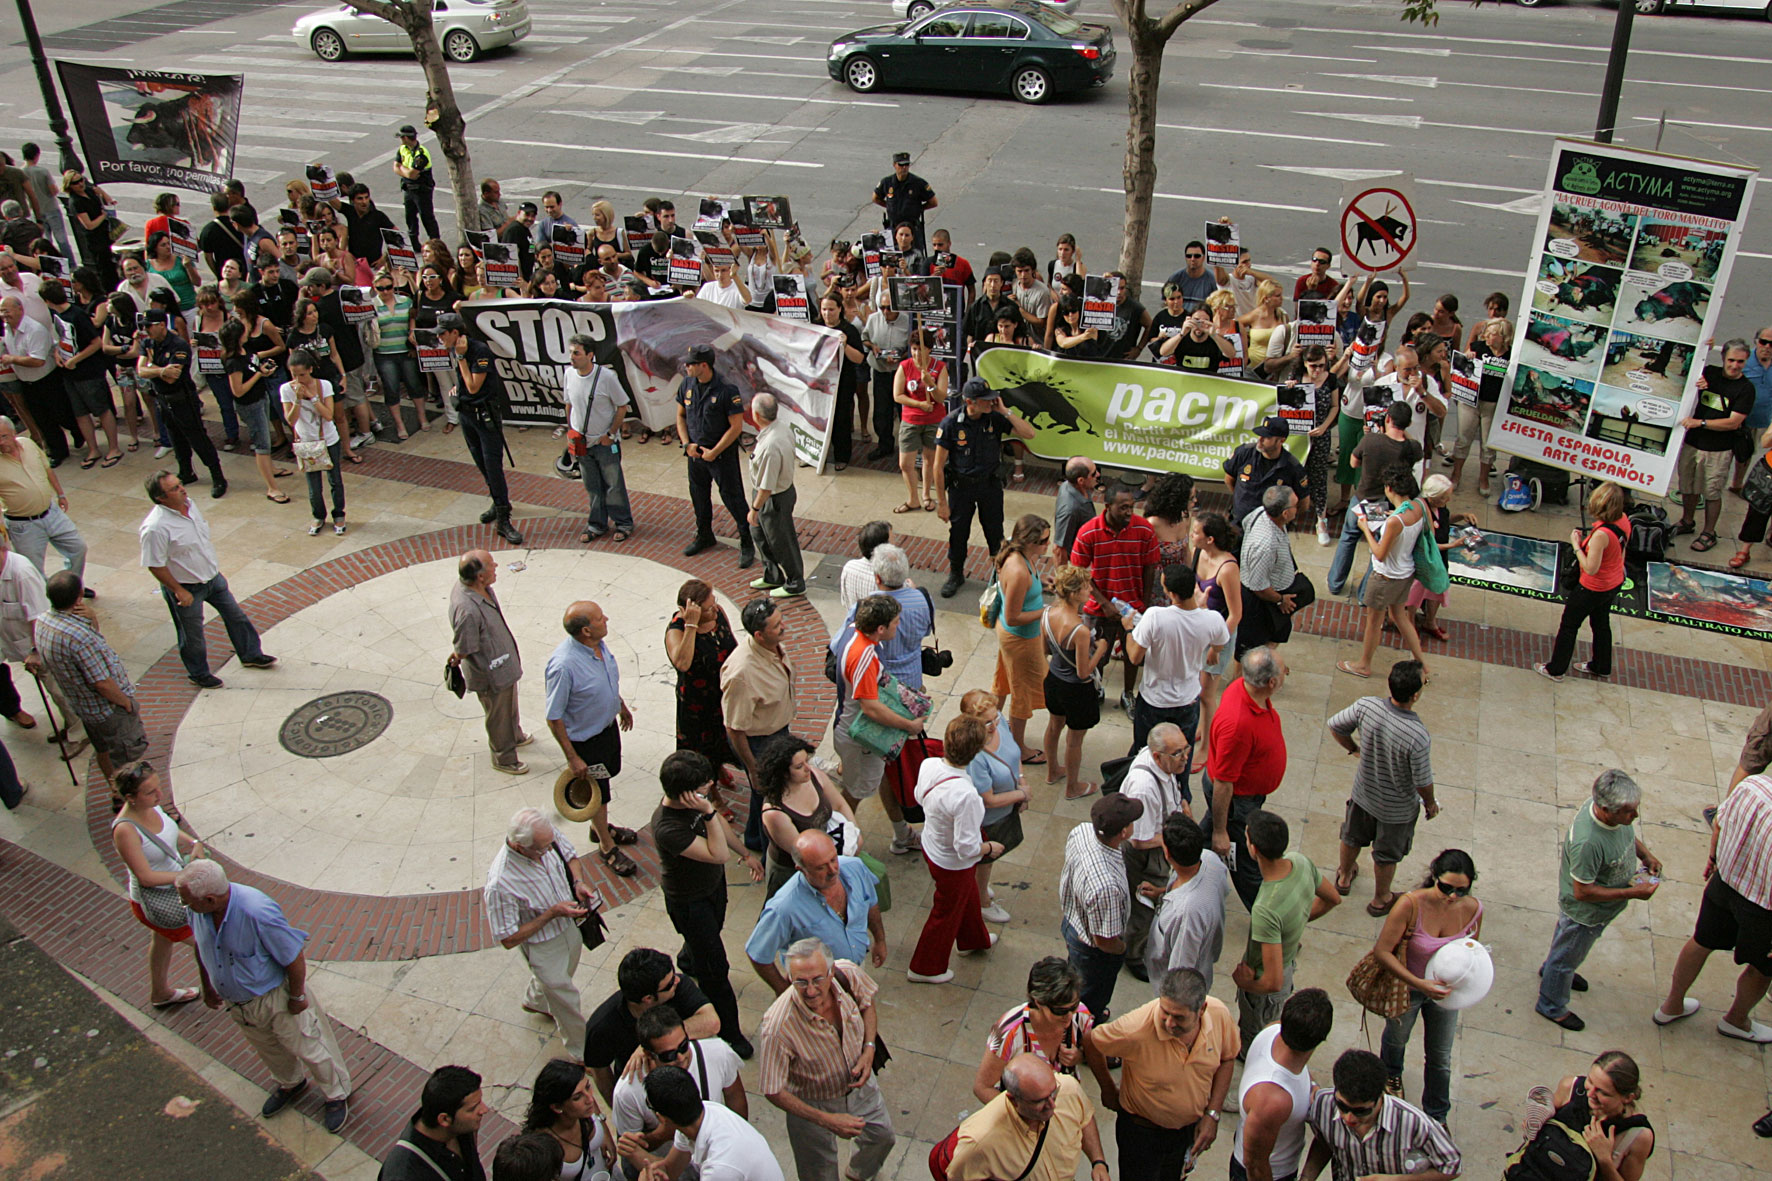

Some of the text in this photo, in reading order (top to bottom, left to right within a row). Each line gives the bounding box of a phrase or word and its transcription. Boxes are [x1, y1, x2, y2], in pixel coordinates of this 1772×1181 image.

[100, 161, 125, 172] Por
[129, 161, 163, 176] favor,
[167, 167, 184, 178] ¡no
[1604, 171, 1673, 199] ACTYMA
[1681, 184, 1733, 199] www.actyma.org
[1570, 195, 1597, 208] CRUEL
[1599, 199, 1632, 215] AGONÍA
[1632, 205, 1650, 216] DEL
[1652, 208, 1677, 221] TORO
[1084, 301, 1115, 311] ¡BASTA!
[476, 308, 606, 364] STOP
[1299, 325, 1334, 334] ¡BASTA!
[494, 358, 566, 389] CORRI
[503, 380, 540, 402] DE
[511, 404, 566, 417] www.Anima
[1279, 409, 1314, 419] ¡BASTA!
[1511, 406, 1564, 425] ¡CRUELDAD!
[1123, 422, 1167, 436] Partit
[1103, 441, 1220, 470] www.pacma.es
[1105, 428, 1232, 459] el Maltractament
[1501, 420, 1635, 468] ¿FIESTA ESPAÑOLA,
[1542, 446, 1655, 486] ARTE ESPAÑOL?
[1450, 576, 1564, 601] ACIÓN CONTRA LA
[1610, 604, 1628, 613] RA
[1645, 610, 1662, 620] EL
[1668, 615, 1742, 634] MALTRATO
